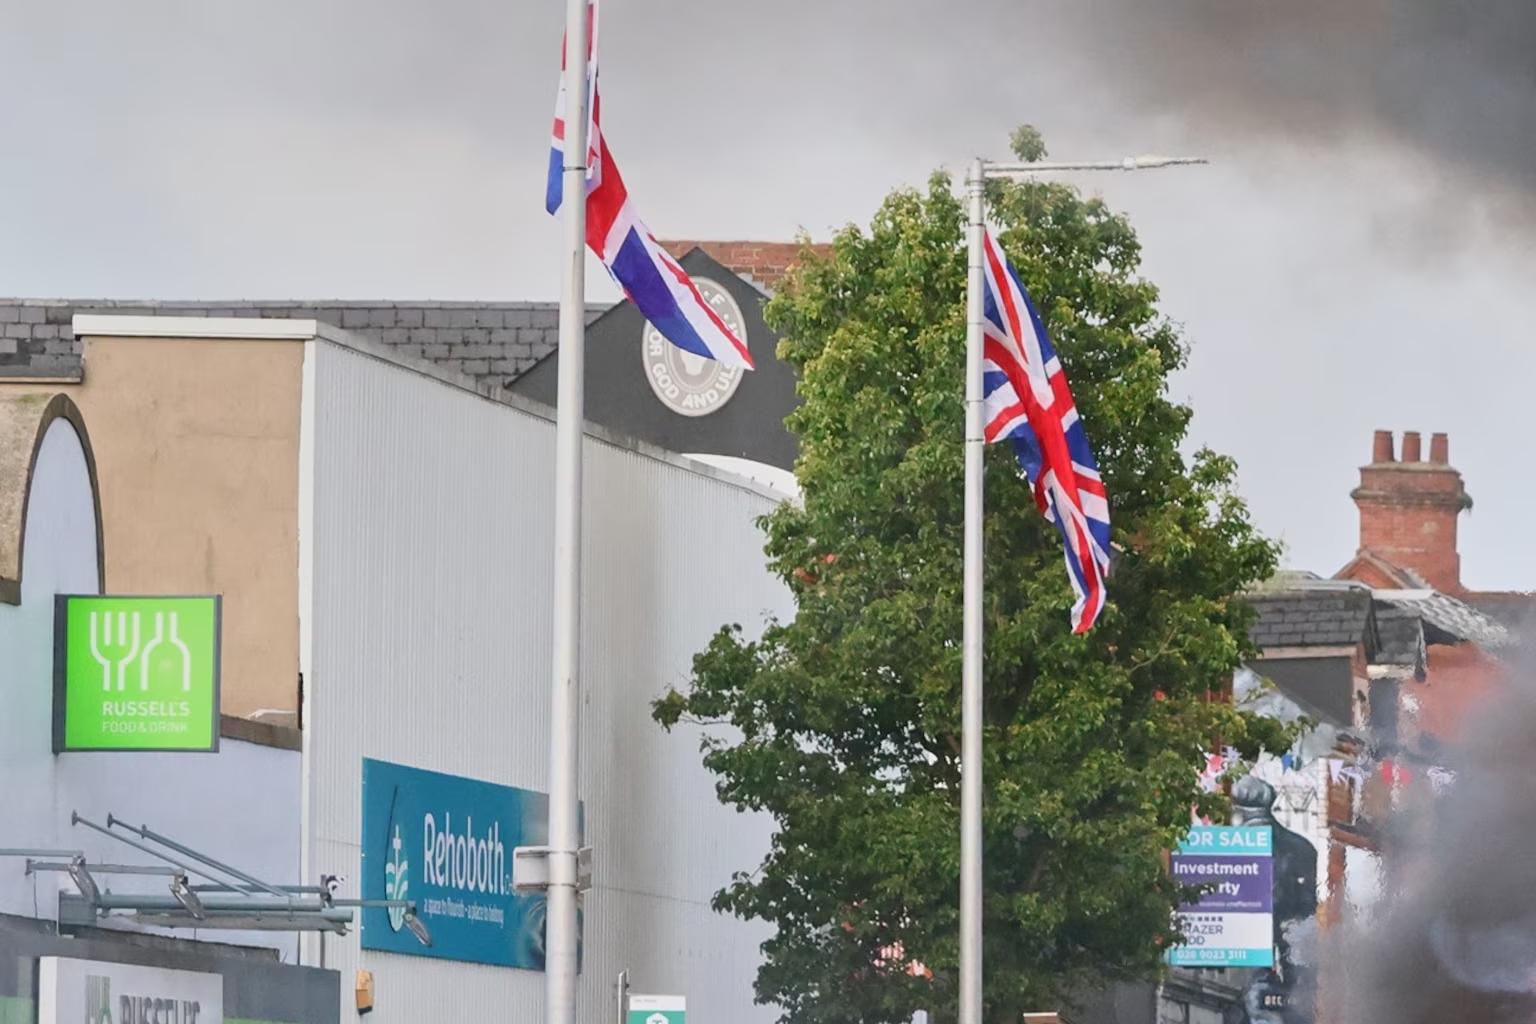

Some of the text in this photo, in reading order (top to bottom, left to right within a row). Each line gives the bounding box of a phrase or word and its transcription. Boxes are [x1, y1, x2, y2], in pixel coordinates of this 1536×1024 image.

[649, 332, 663, 356] OR
[652, 363, 679, 398] GOD
[681, 389, 719, 409] AND
[102, 701, 190, 717] RUSSELL'S
[1187, 831, 1268, 847] OR SALE
[424, 811, 505, 896] Rehoboth
[1174, 861, 1259, 876] Investment
[1184, 924, 1224, 935] RAZER
